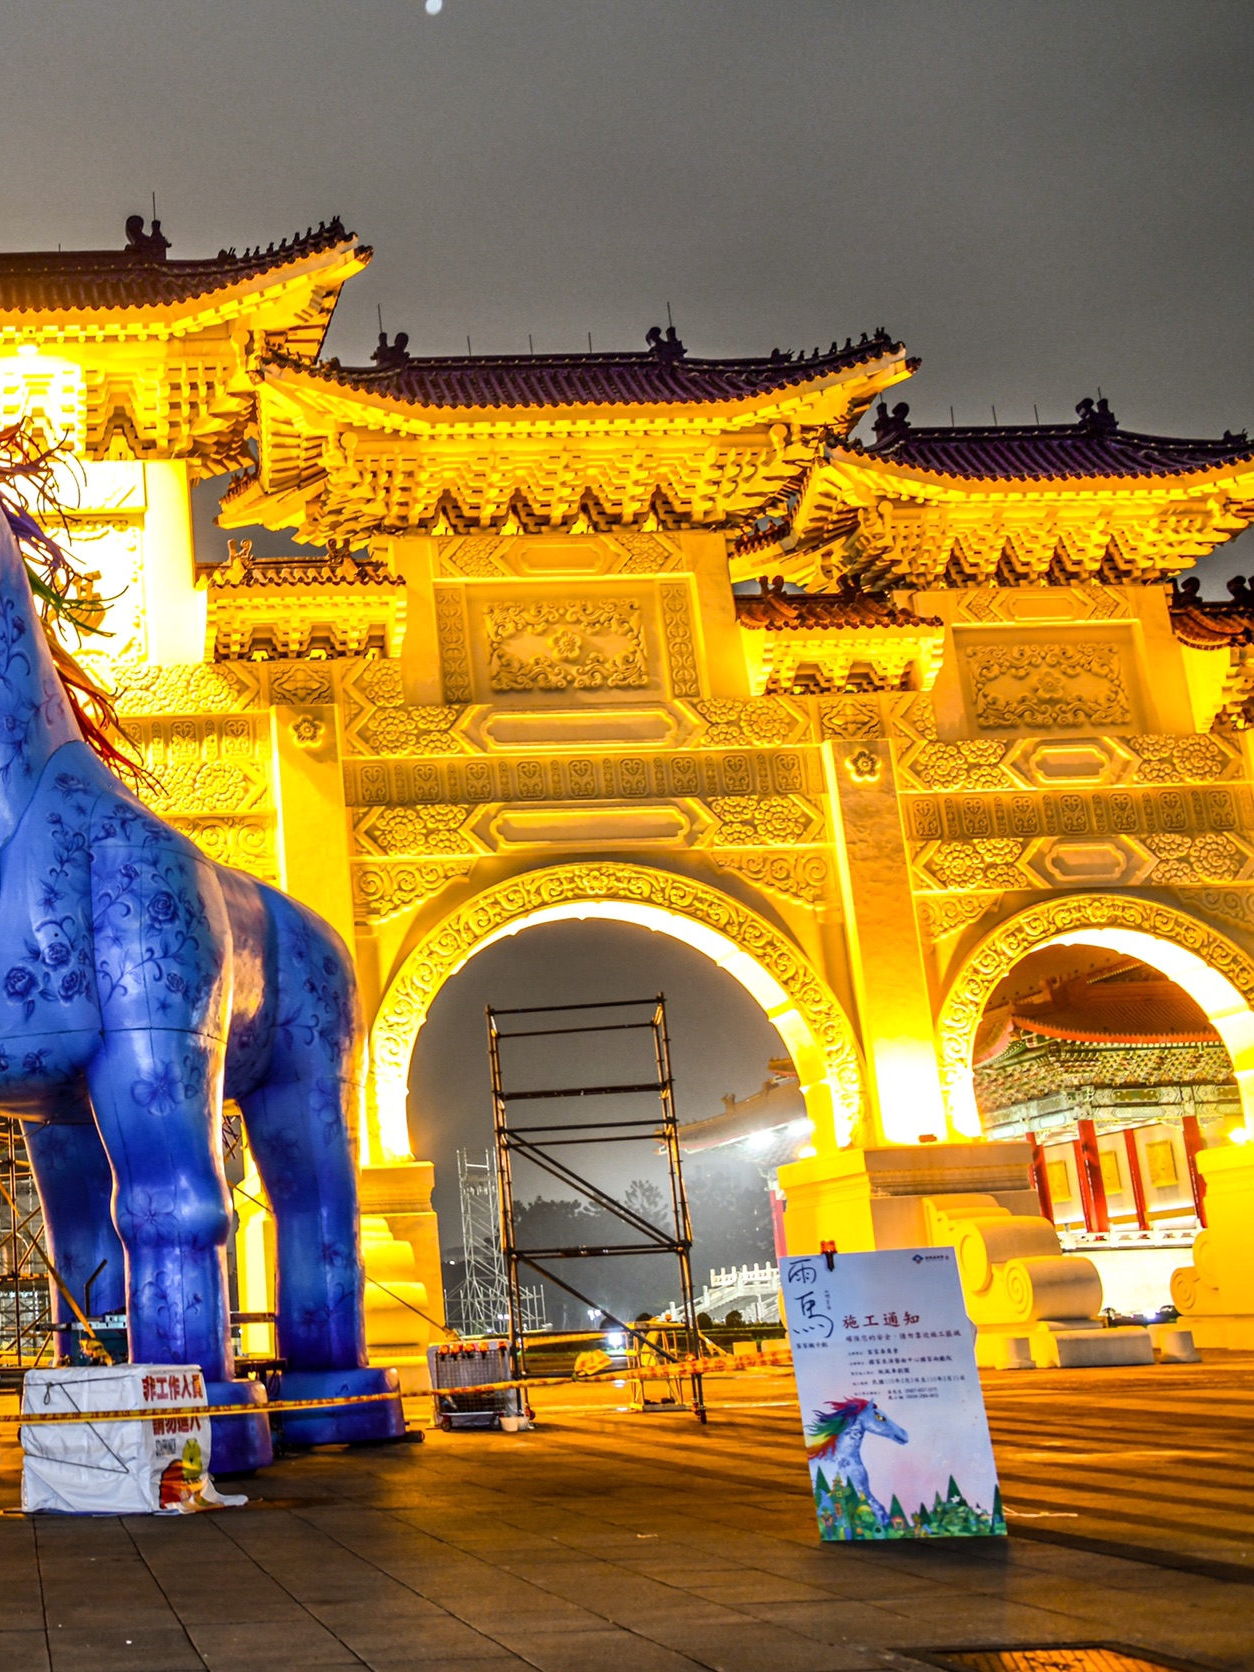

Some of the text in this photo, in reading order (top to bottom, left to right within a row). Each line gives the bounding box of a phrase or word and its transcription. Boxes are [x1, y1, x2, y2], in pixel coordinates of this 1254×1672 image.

[842, 1311, 921, 1330] 施工通知
[142, 1374, 203, 1402] 非工作人員
